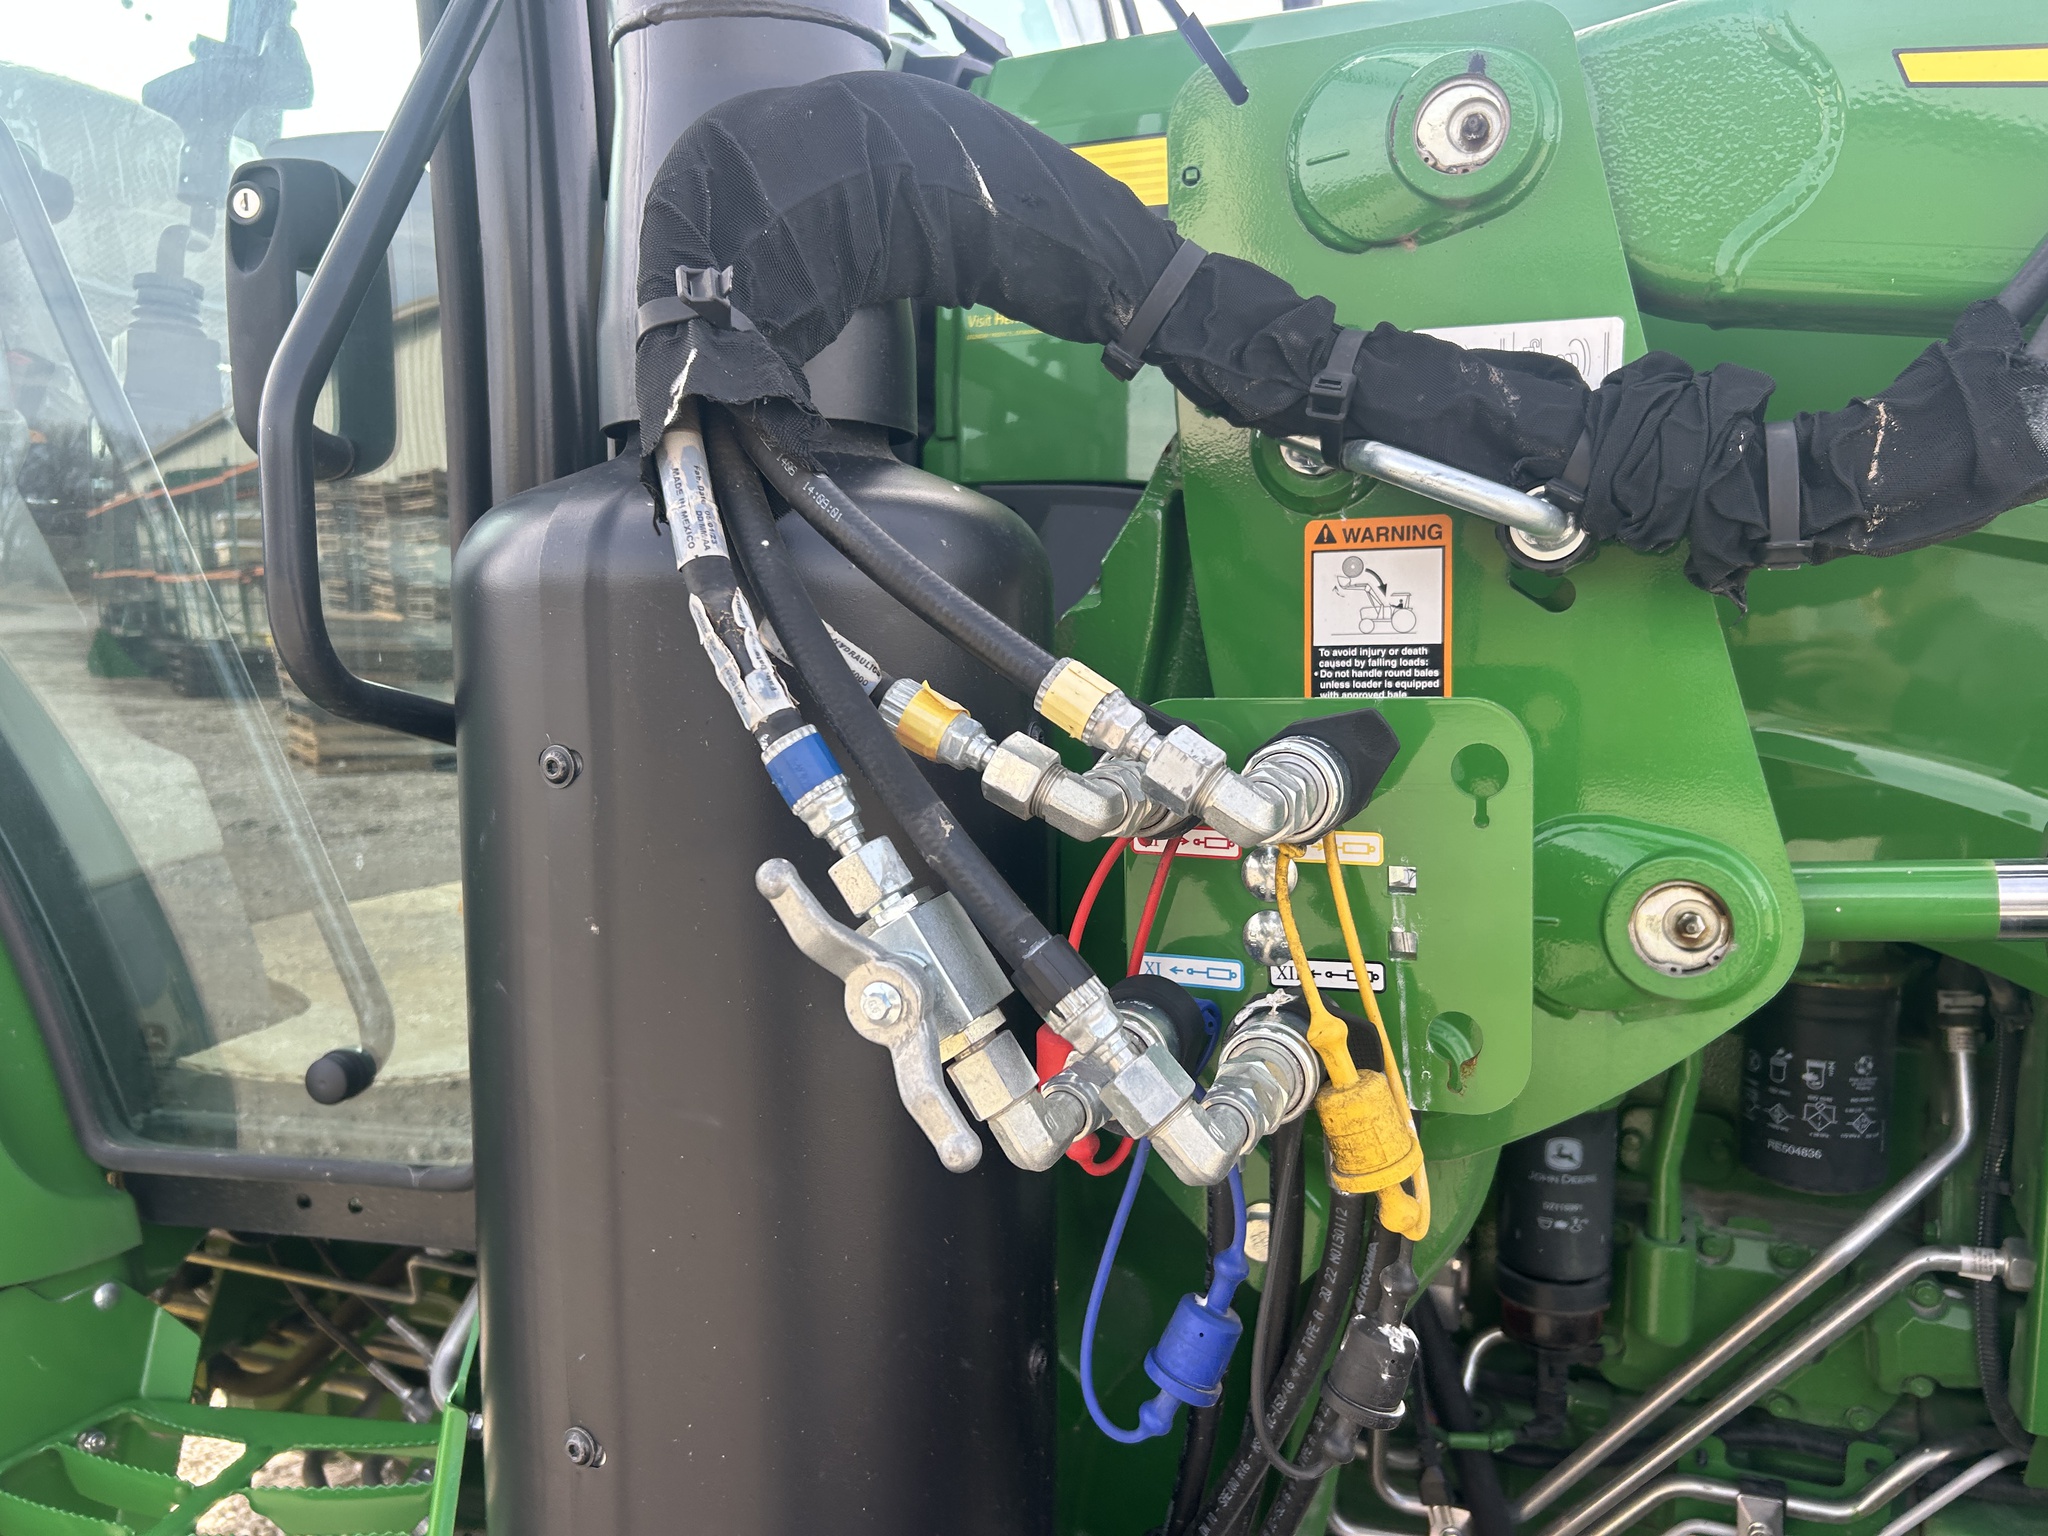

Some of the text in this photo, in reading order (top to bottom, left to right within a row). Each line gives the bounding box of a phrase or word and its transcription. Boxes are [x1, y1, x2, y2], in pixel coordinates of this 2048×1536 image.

[672, 467, 696, 550] MADE IN MEXICO
[802, 481, 843, 522] 14:09:01
[1342, 524, 1443, 544] WARNING
[1319, 646, 1428, 658] To avoid injury or death
[1319, 658, 1429, 669] caused by falling loads:
[852, 670, 869, 687] 000
[1320, 668, 1440, 678] Do not handle round bales
[1320, 679, 1440, 690] unless loader is equipped
[1341, 690, 1385, 698] approved
[1387, 690, 1408, 698] bale
[1767, 1139, 1822, 1160] RE504836
